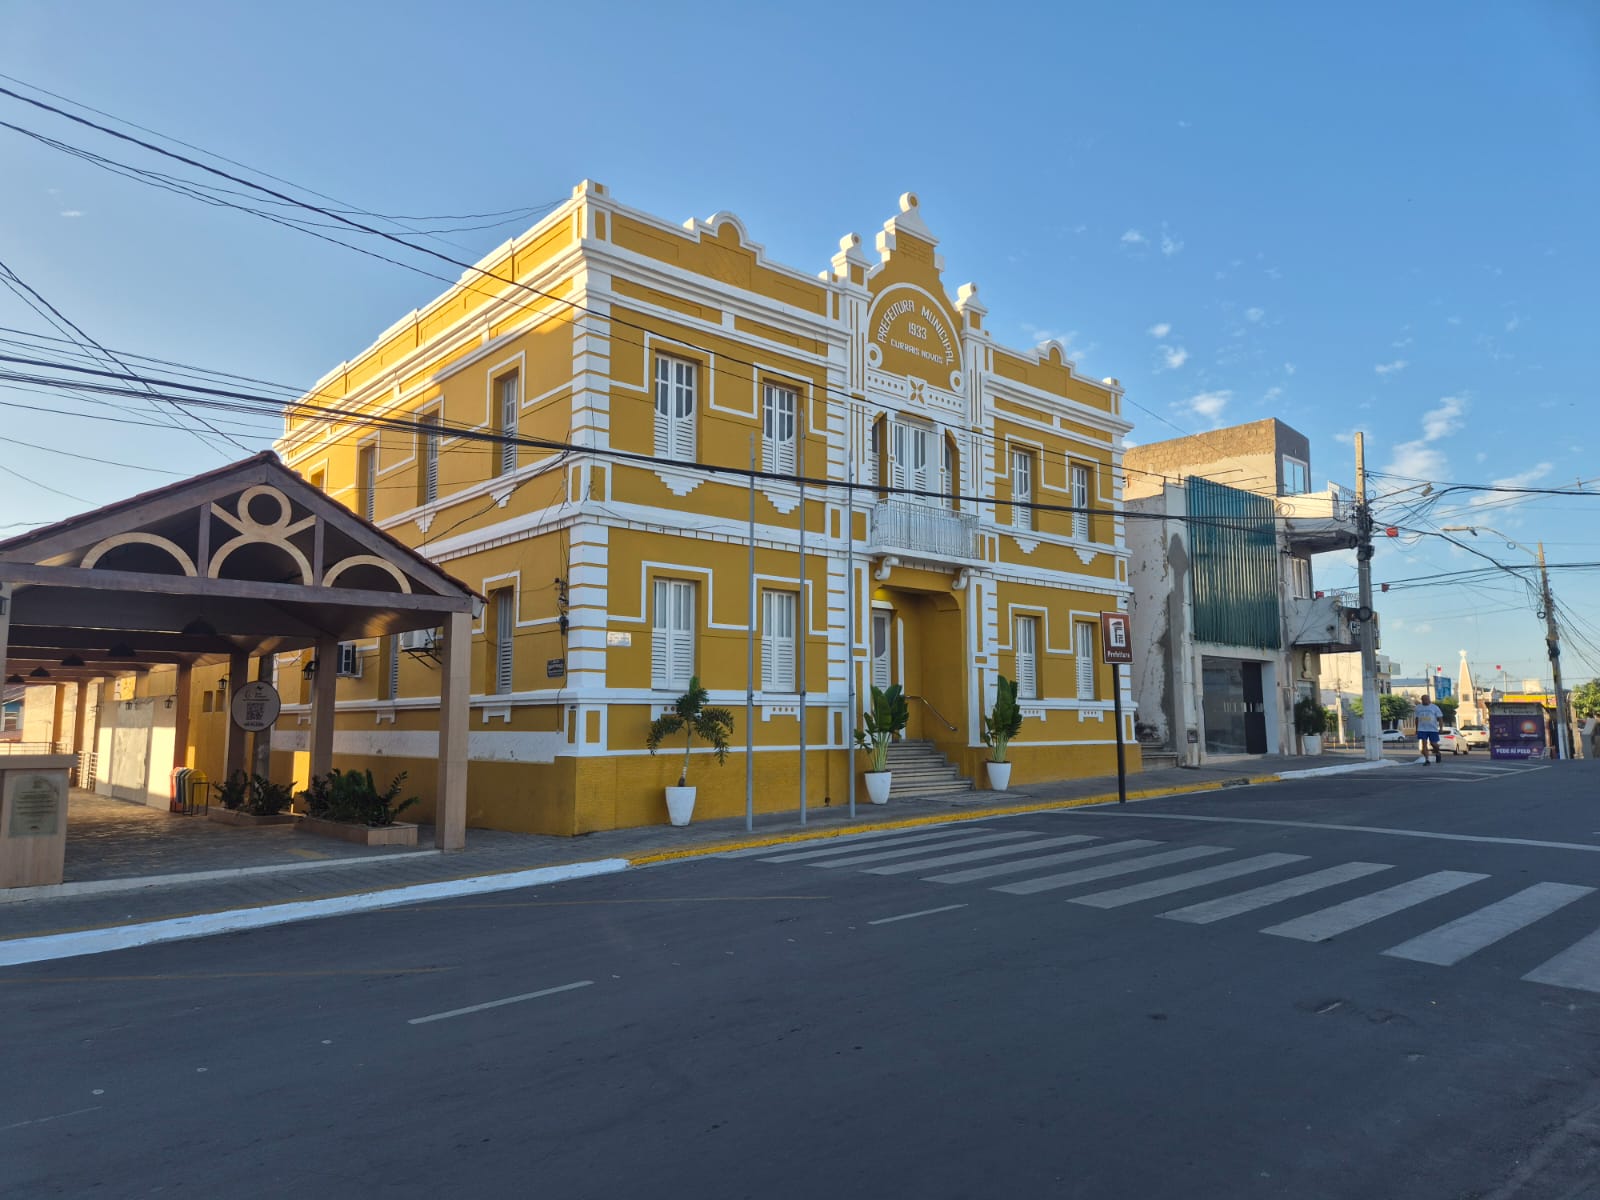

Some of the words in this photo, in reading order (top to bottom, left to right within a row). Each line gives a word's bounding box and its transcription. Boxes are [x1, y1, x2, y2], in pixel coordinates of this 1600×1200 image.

[878, 300, 914, 343] PREFEITURA
[921, 306, 954, 366] MUNICIPAL
[909, 321, 927, 339] 1933
[890, 338, 920, 356] CURRAIS
[921, 350, 943, 364] NOVOS
